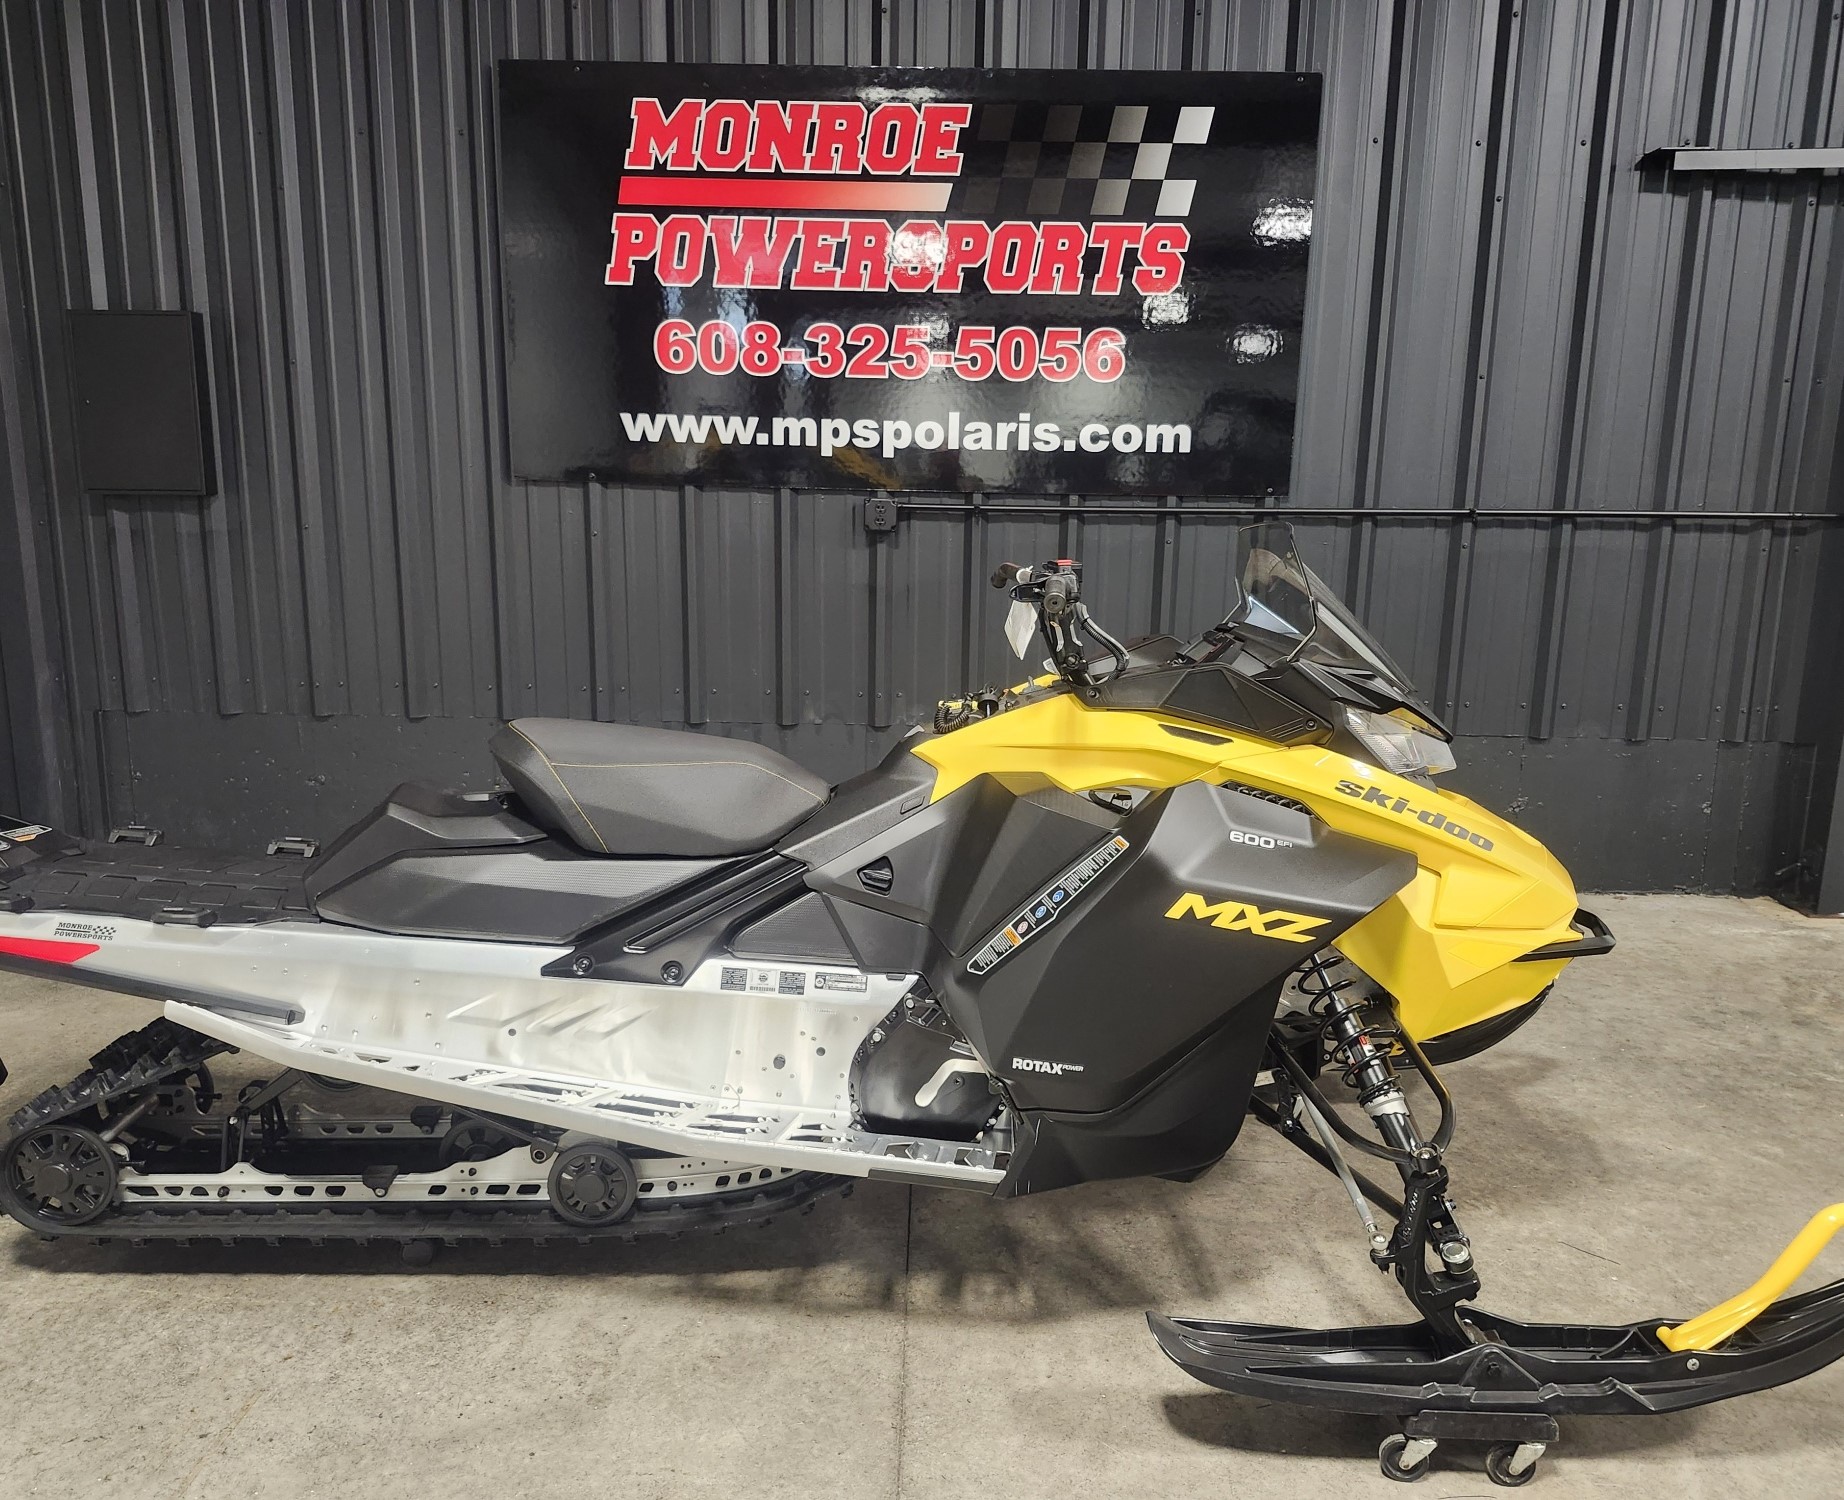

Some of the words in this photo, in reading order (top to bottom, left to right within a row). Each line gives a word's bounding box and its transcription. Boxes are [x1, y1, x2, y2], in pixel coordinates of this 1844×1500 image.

[623, 97, 973, 176] MONROE
[604, 212, 1191, 296] POWERSPORTS
[653, 319, 1127, 384] 608-325-5056
[620, 411, 1193, 459] www.mpspolaris.com
[1229, 830, 1275, 849] 600
[54, 930, 114, 941] POWERSPORTS
[58, 921, 93, 931] MONROE
[1164, 891, 1332, 944] MXZ
[1012, 1057, 1063, 1075] ROTAX
[1062, 1064, 1084, 1073] POWER
